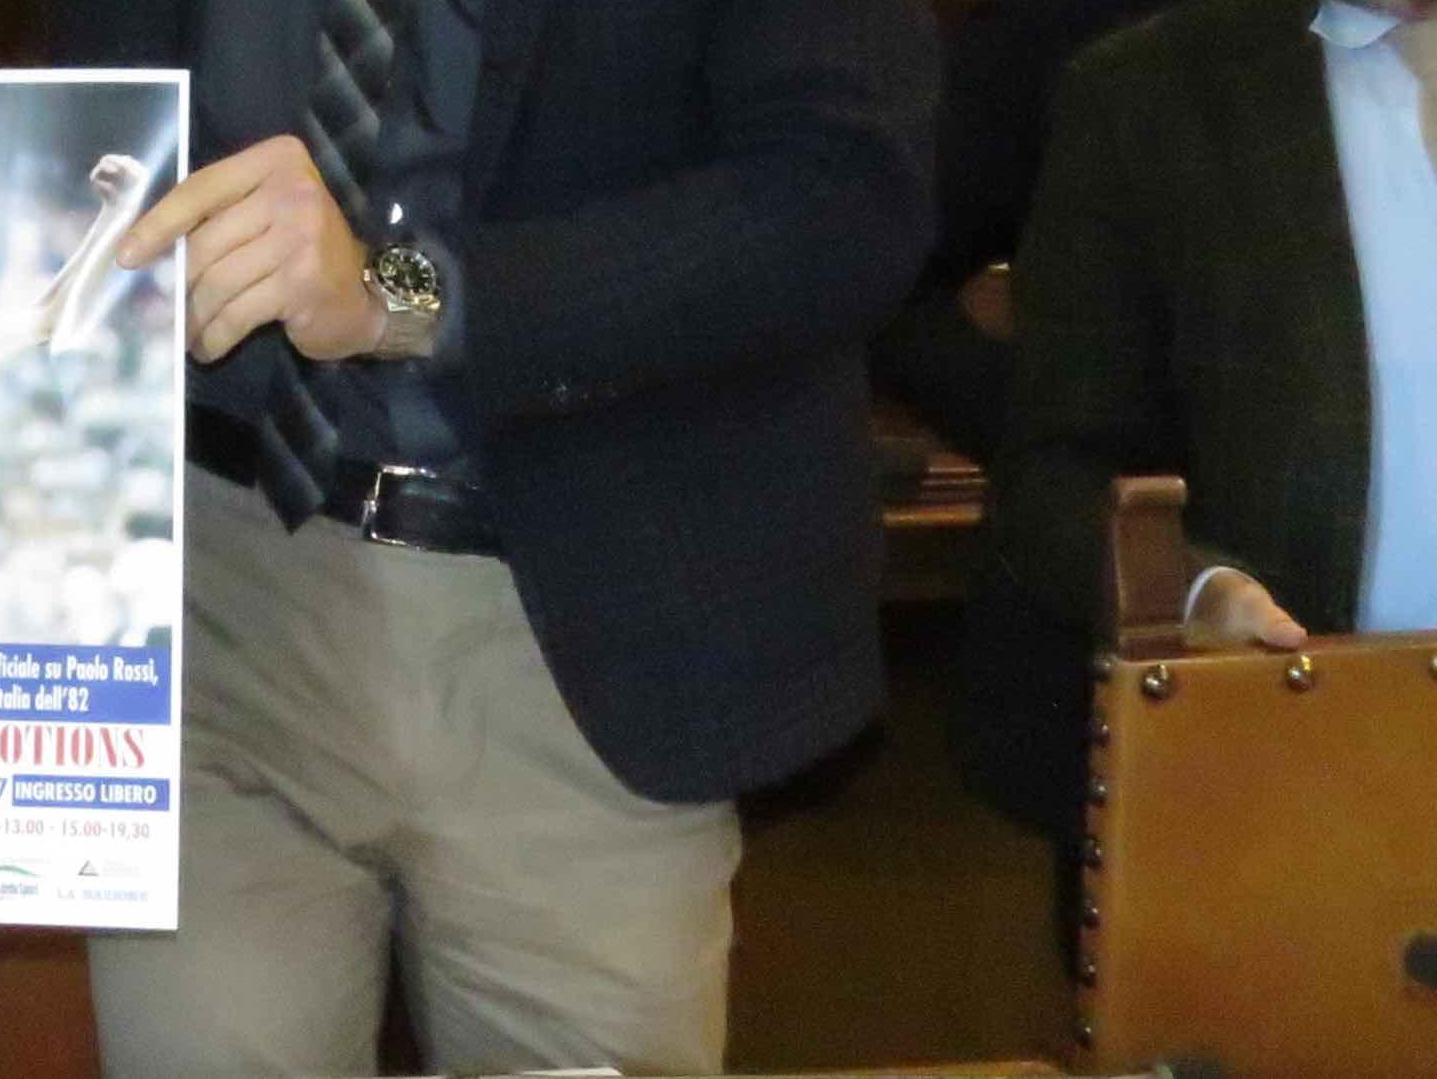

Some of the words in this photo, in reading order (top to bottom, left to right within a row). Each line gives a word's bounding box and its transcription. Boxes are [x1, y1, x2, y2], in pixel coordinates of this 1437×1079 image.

[44, 663, 62, 680] su
[66, 656, 109, 680] Paolo
[113, 657, 159, 685] Rossi,
[35, 690, 89, 712] dell'82
[14, 783, 95, 803] INGRESSO
[99, 784, 157, 805] LIBERO
